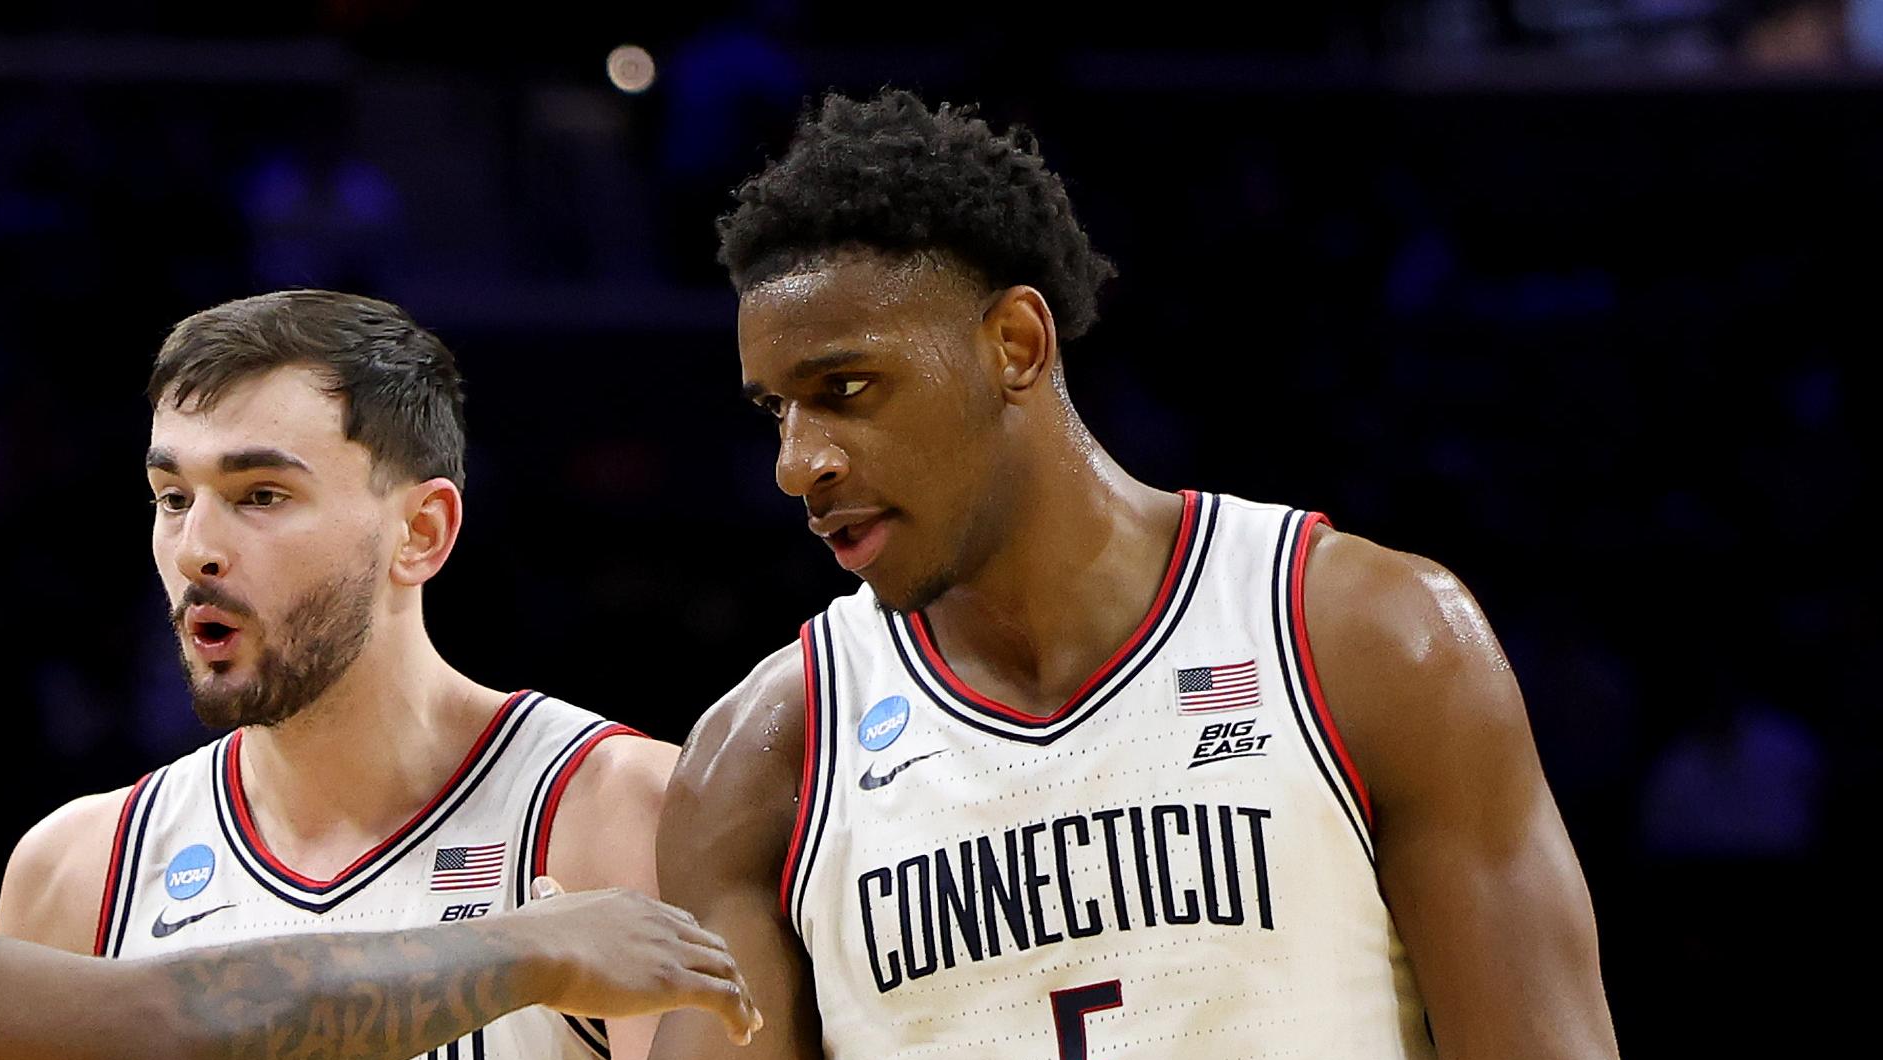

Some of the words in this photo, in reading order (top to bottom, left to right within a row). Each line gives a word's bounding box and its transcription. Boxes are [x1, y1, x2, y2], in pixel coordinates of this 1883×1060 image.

[864, 711, 906, 742] NCAA
[1199, 718, 1257, 741] BIG
[1192, 734, 1273, 759] EAST
[168, 866, 211, 888] NCAA
[857, 803, 1276, 994] CONNECTICUT
[439, 901, 494, 922] BIG
